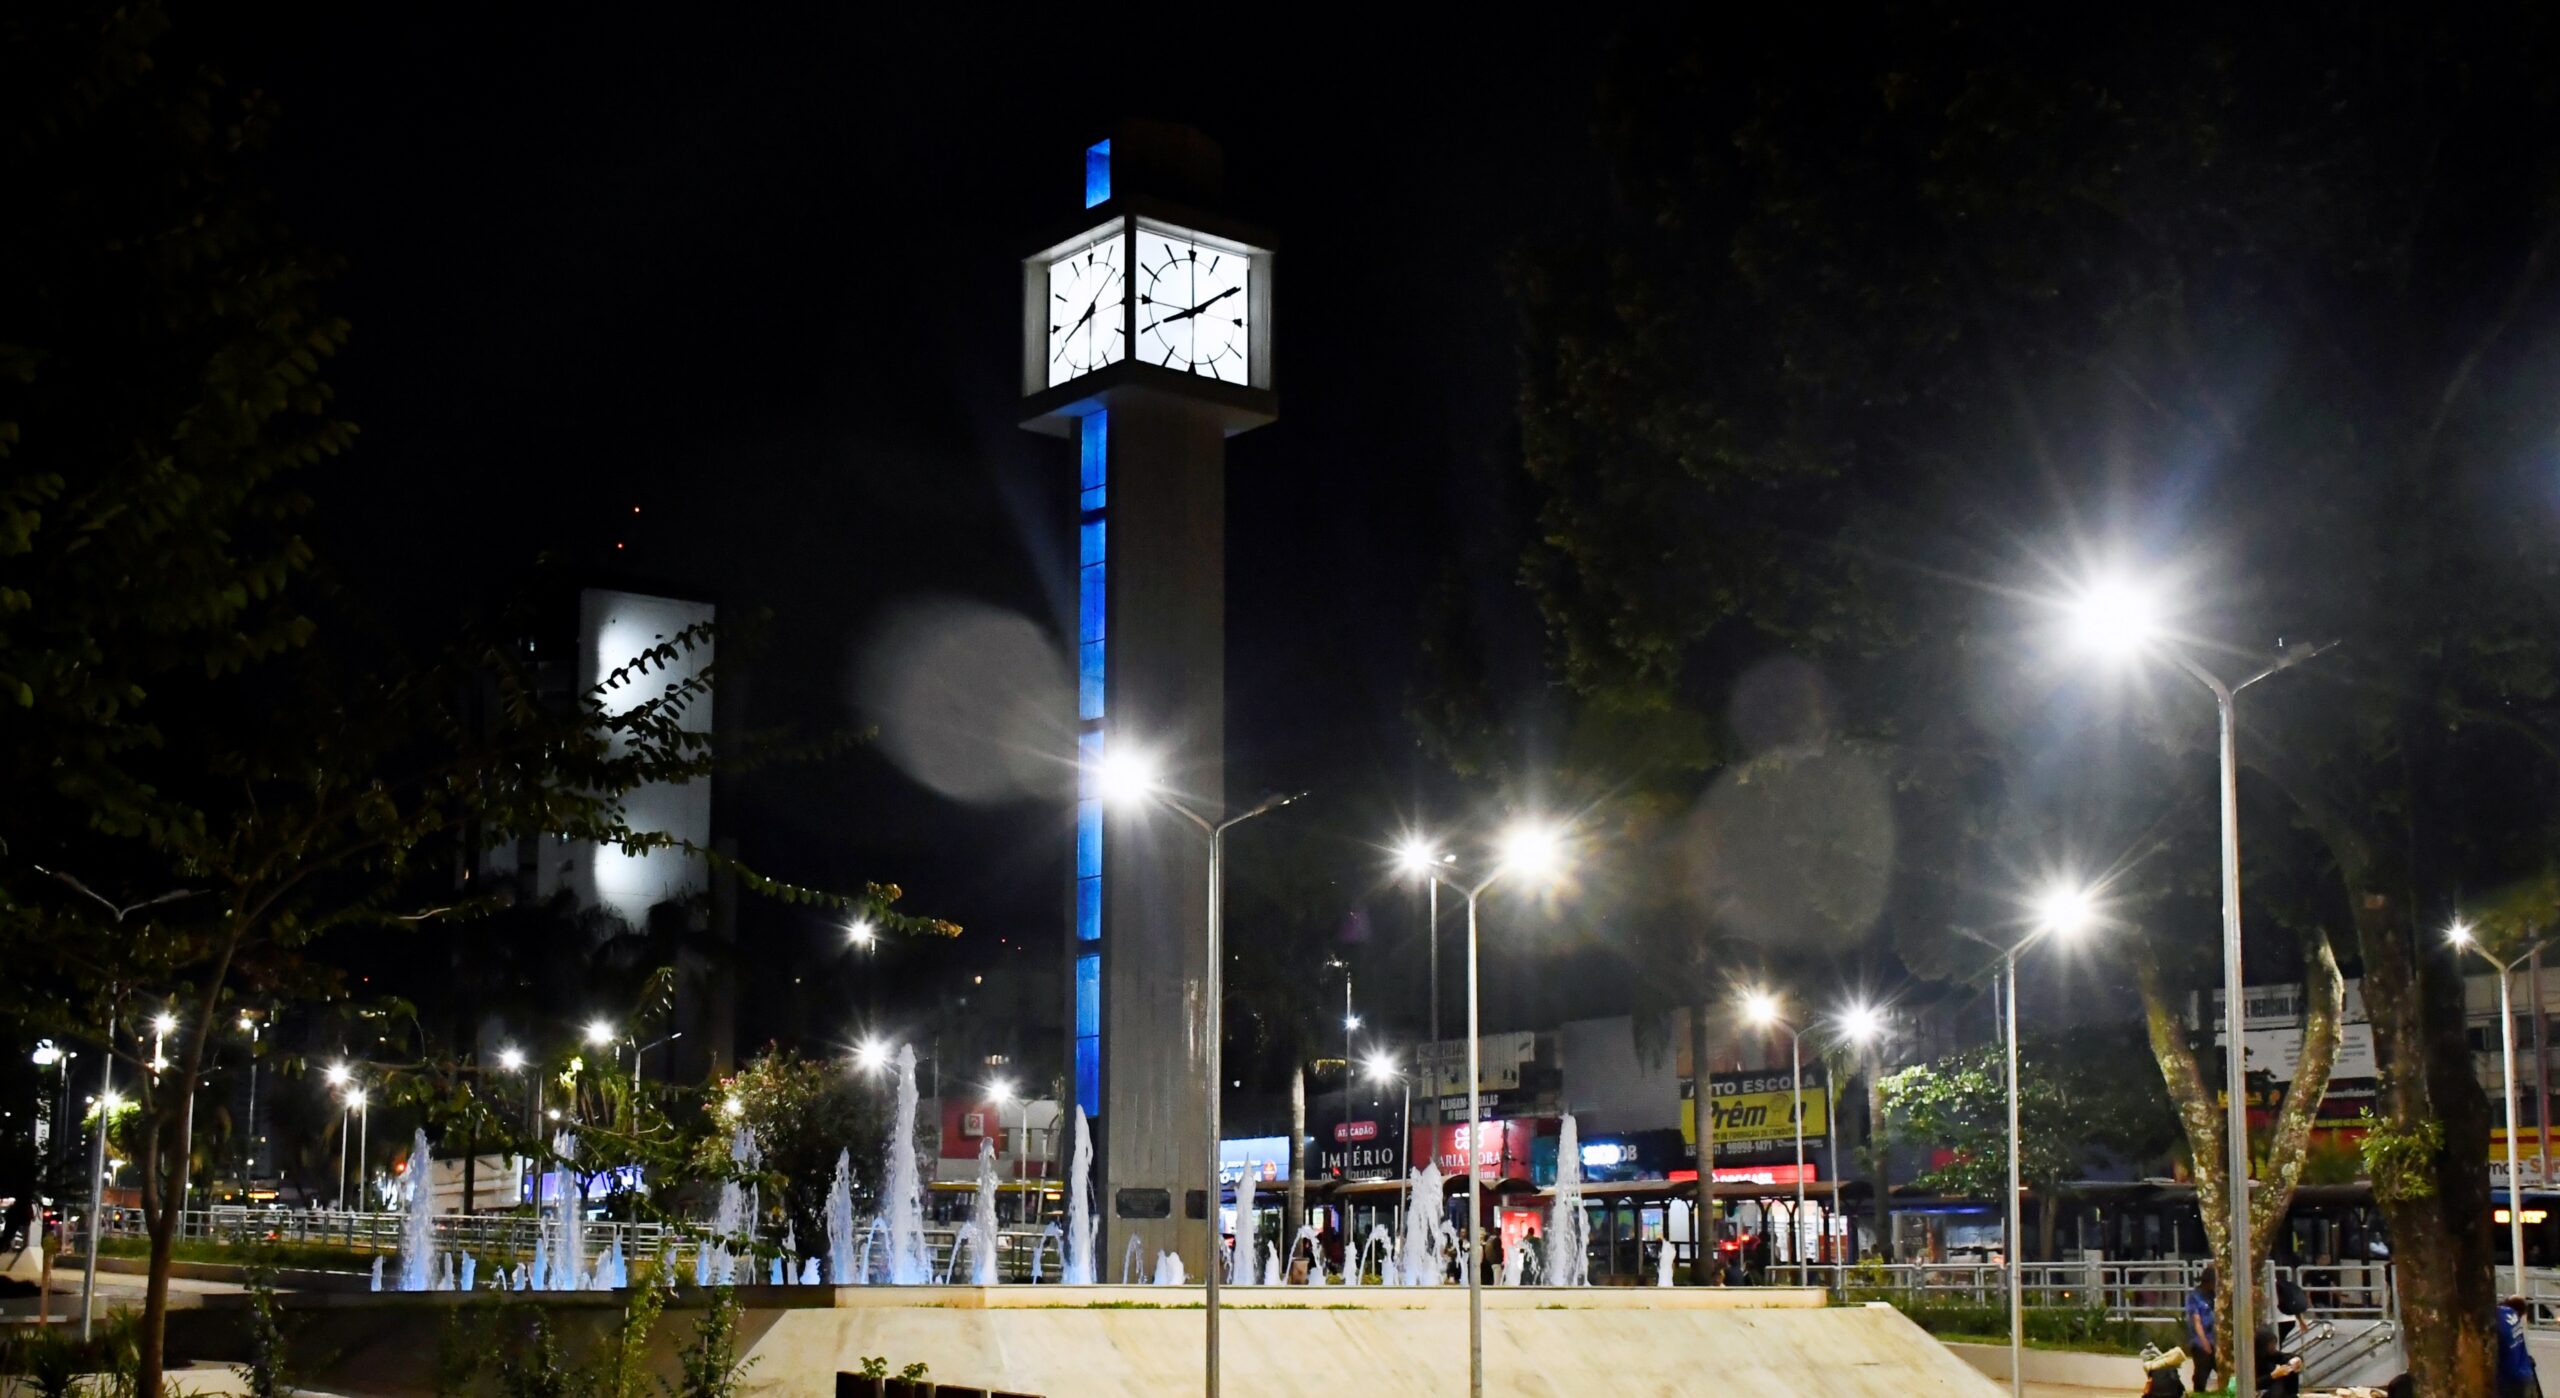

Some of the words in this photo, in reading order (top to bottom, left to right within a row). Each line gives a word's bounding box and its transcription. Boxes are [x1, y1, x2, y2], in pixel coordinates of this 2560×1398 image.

[1688, 1081, 1737, 1097] ATO
[1742, 1075, 1816, 1094] ESCOA
[1439, 1152, 1465, 1167] ARIA
